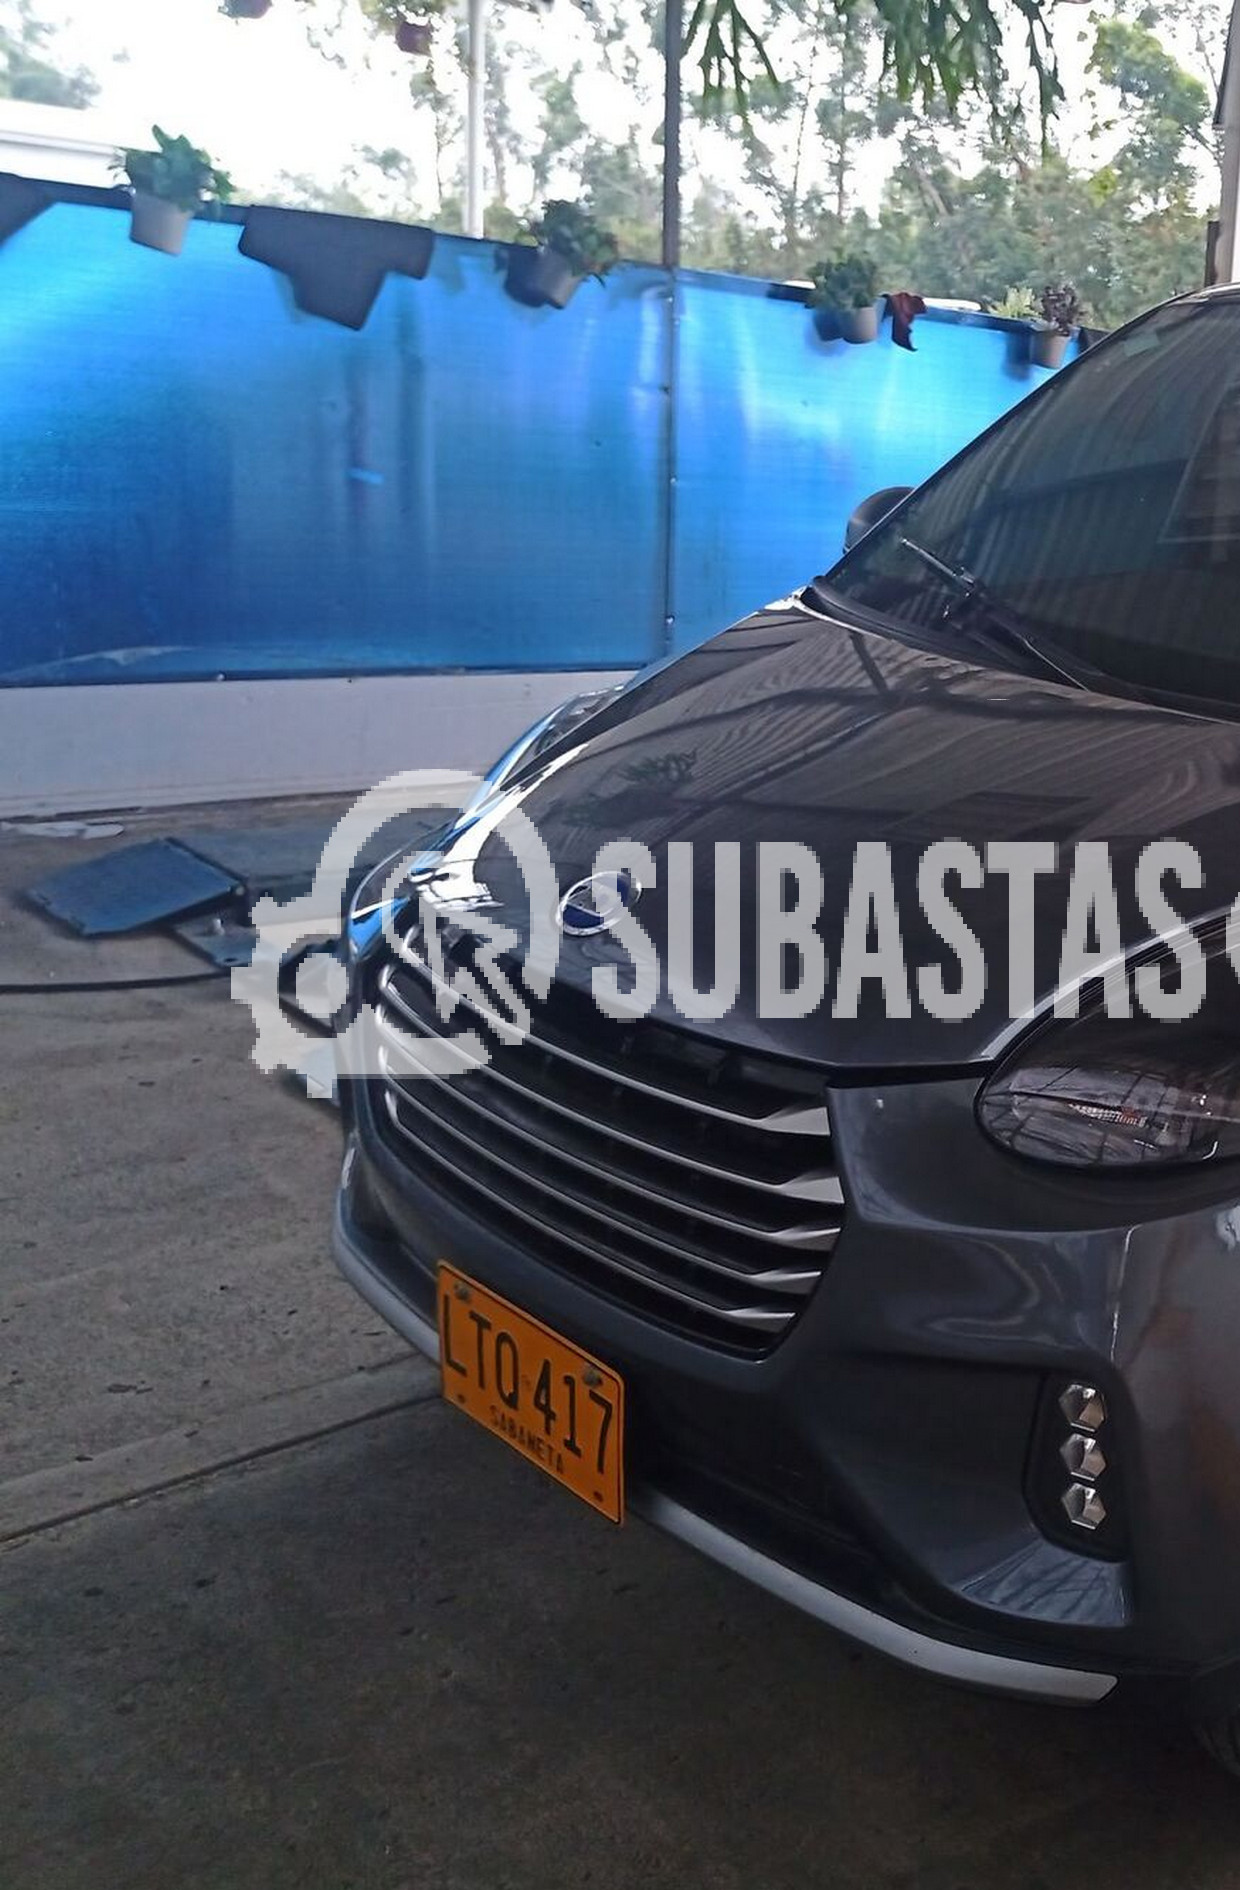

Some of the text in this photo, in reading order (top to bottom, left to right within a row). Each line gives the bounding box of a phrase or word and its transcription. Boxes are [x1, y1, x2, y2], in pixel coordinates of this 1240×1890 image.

[444, 1293, 613, 1475] LTQ 417
[490, 1405, 564, 1475] SABANETA
